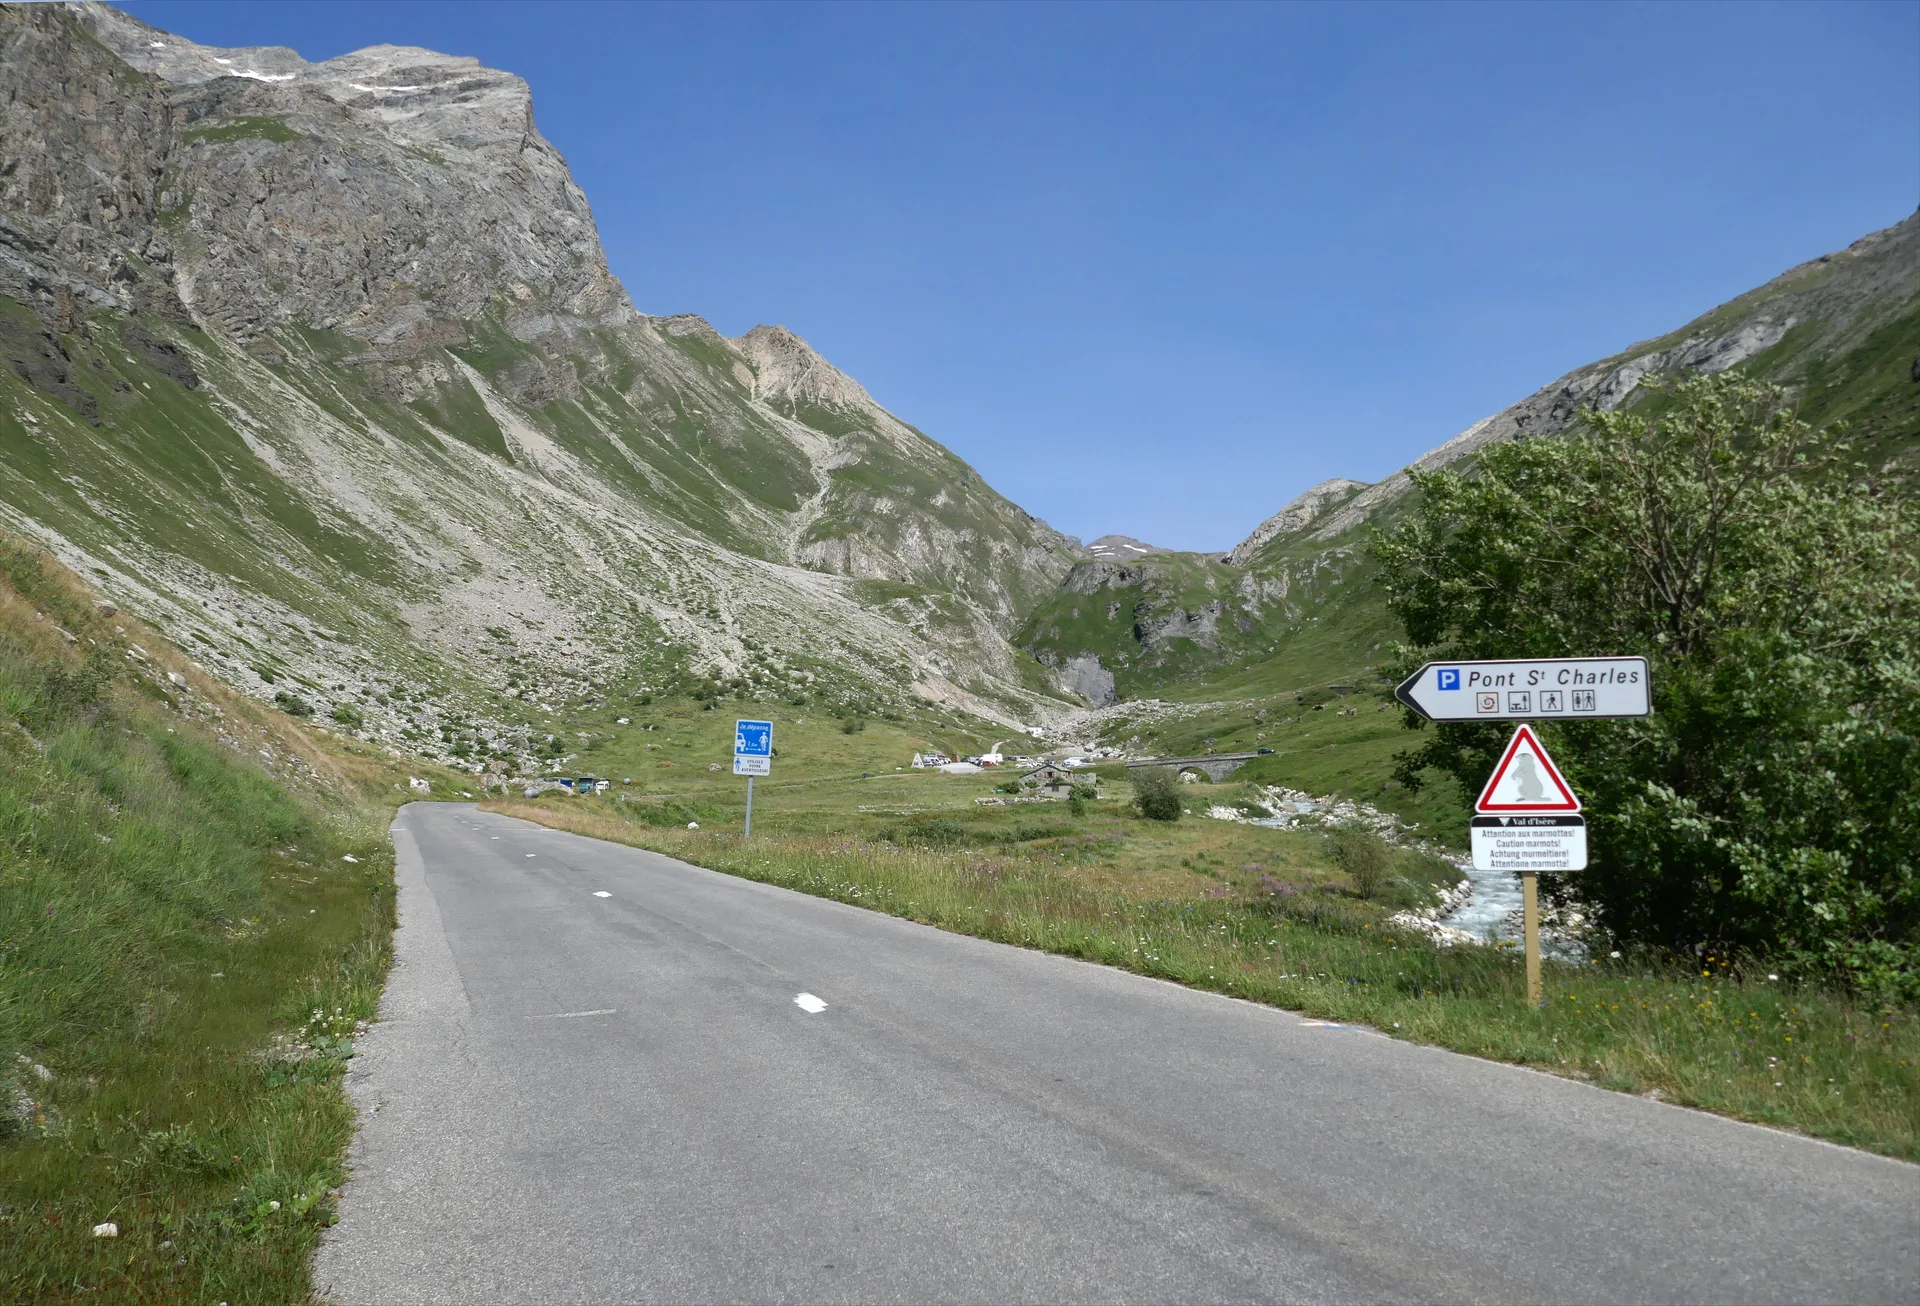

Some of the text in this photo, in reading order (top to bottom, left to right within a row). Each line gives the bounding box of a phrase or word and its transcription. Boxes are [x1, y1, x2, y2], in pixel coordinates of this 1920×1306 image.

[1468, 671, 1515, 687] Pont
[1527, 670, 1545, 685] St
[1557, 668, 1639, 685] Charles
[1513, 817, 1556, 826] Val d'Isère
[1482, 829, 1516, 838] Attention
[1532, 829, 1575, 838] marmottes!
[1496, 839, 1561, 847] Caution marmots!
[1490, 849, 1569, 859] Achtung murmeltiere!
[1491, 859, 1569, 868] Attentione marmotte!
